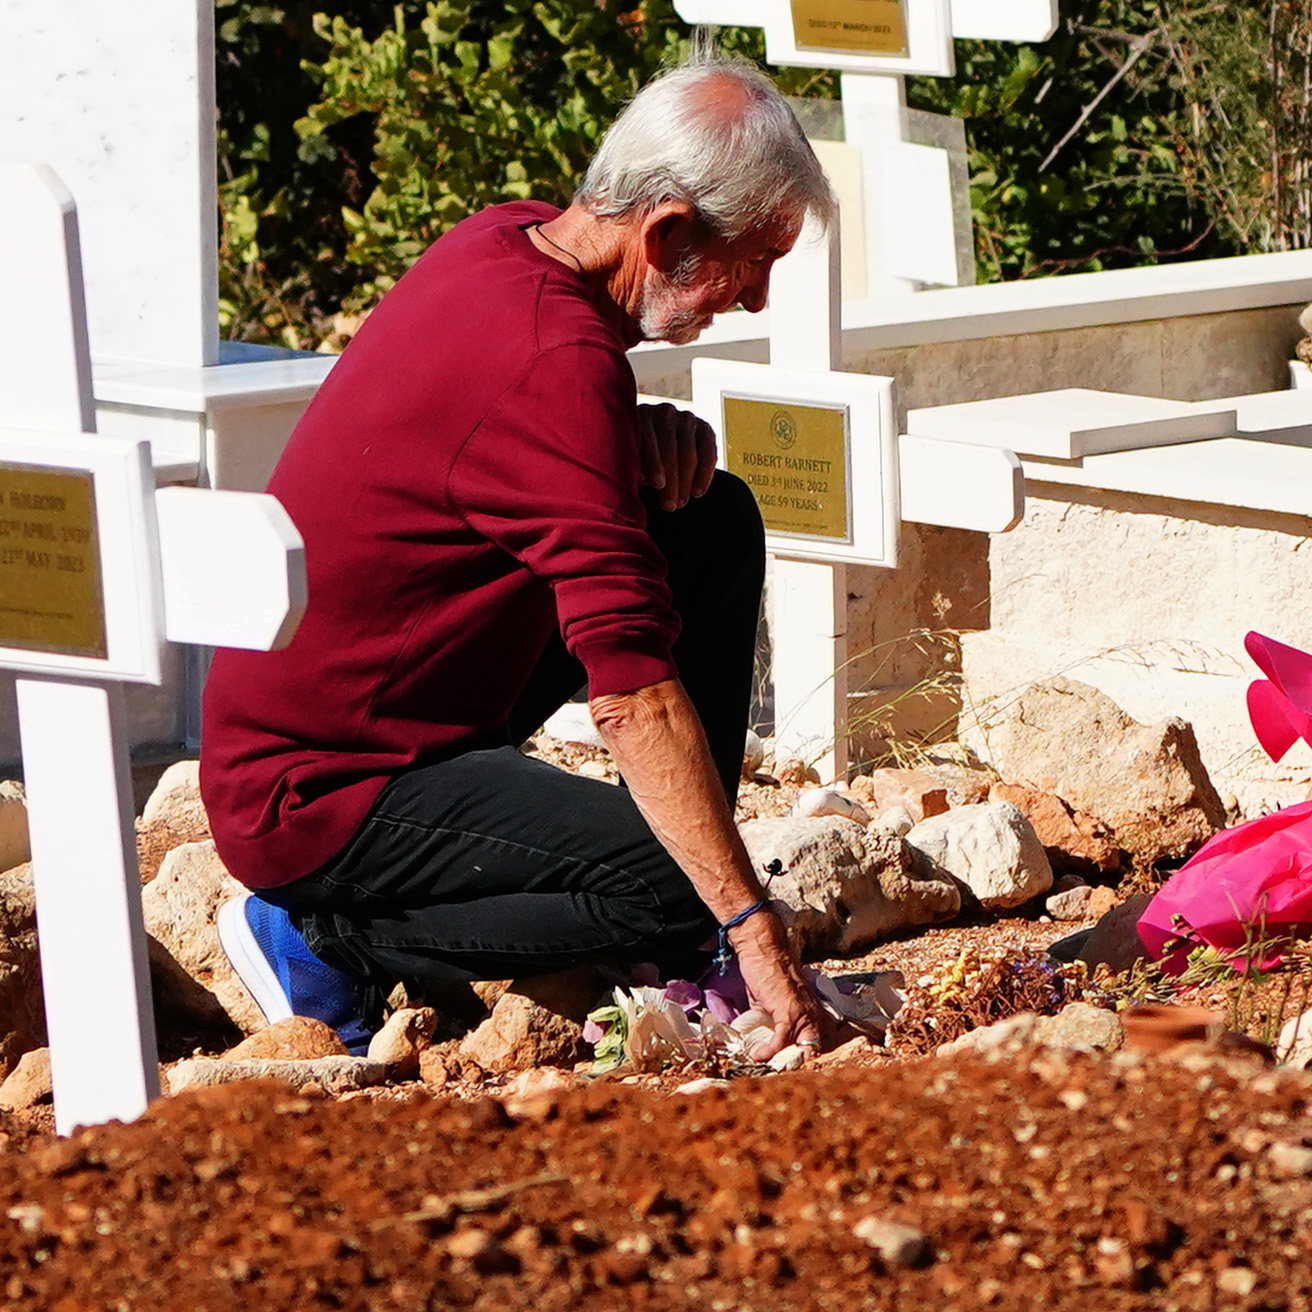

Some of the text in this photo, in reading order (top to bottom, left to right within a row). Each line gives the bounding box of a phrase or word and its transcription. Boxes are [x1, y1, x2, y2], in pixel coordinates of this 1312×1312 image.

[743, 452, 832, 474] ROBERT BARNETT
[747, 473, 769, 486] DIED
[783, 477, 806, 491] JUNE
[806, 479, 828, 493] 2022
[758, 494, 819, 511] AGE 59 YEARS
[25, 549, 53, 570] MAY
